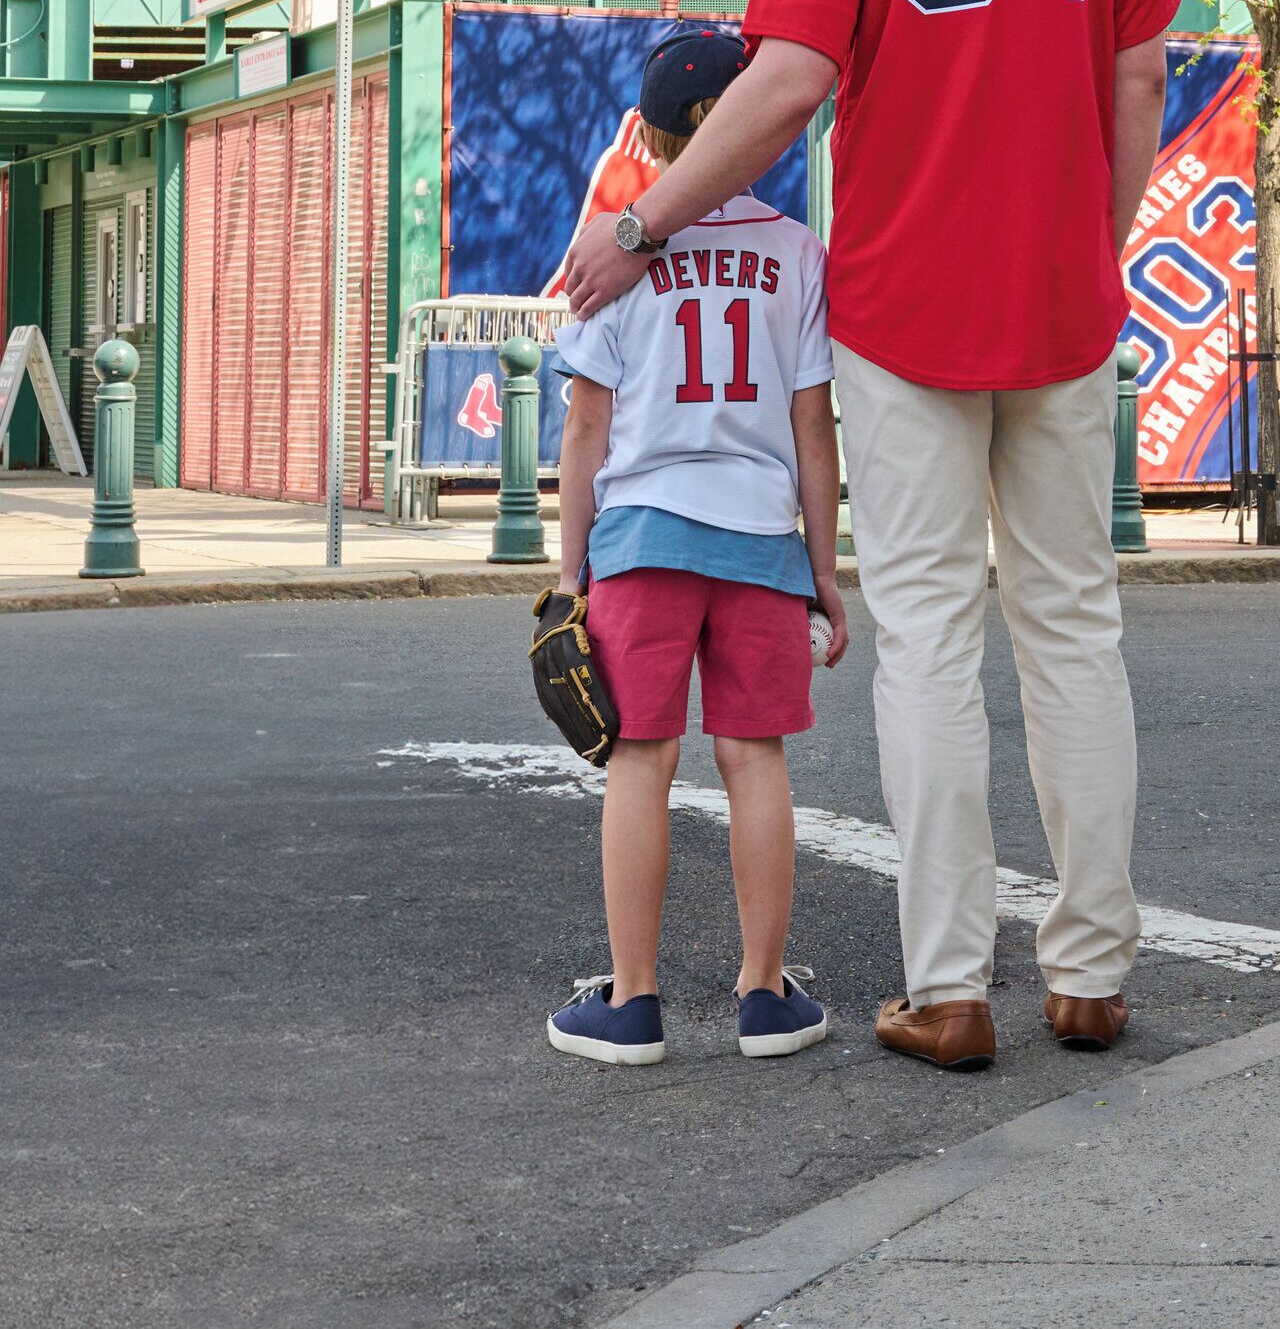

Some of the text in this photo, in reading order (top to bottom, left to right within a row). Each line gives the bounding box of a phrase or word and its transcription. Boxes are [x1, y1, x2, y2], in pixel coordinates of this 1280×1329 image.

[1125, 154, 1207, 246] RIES
[647, 249, 781, 296] DEVERS
[675, 298, 759, 403] 11
